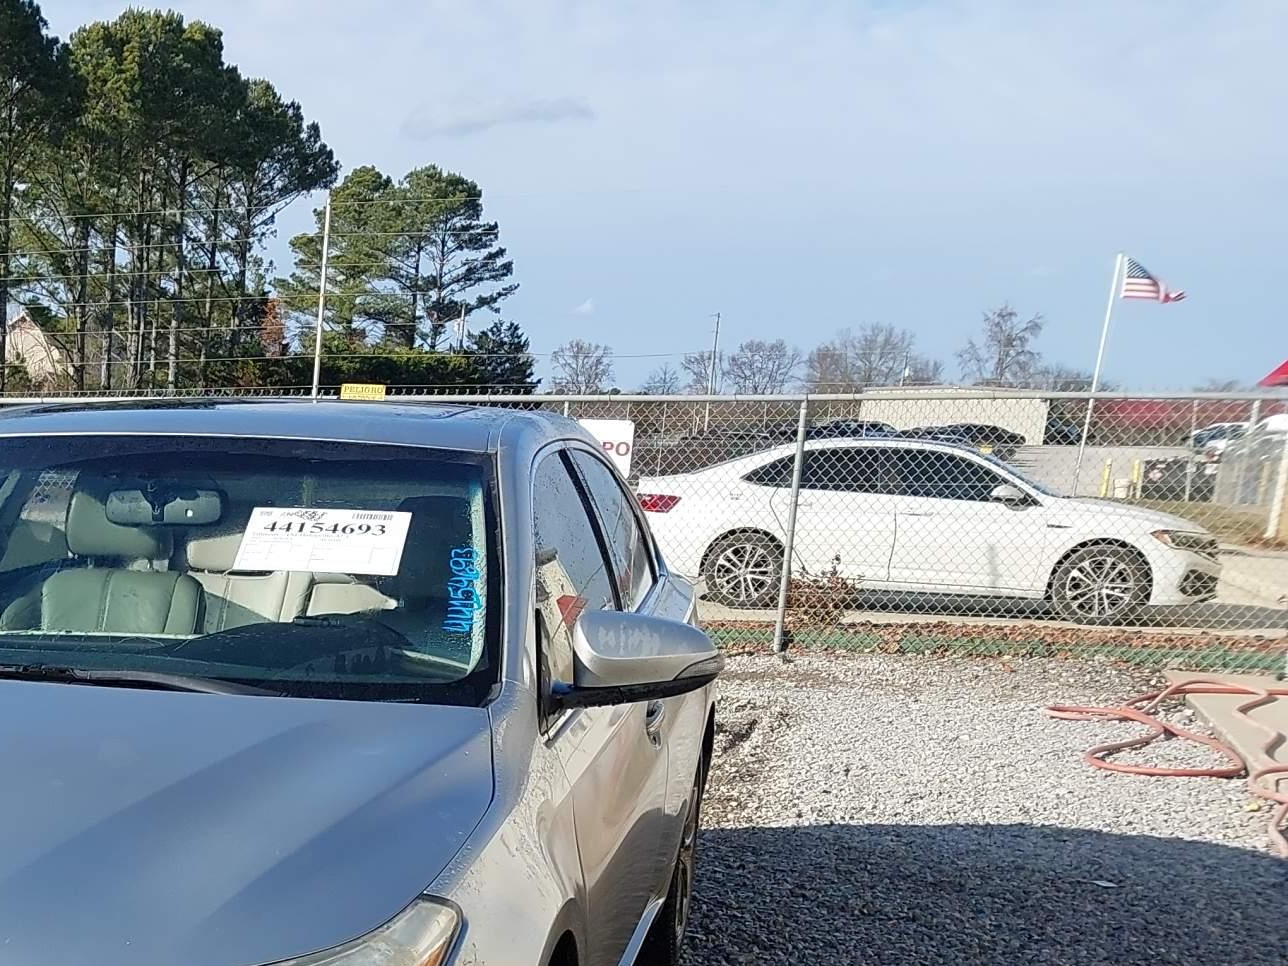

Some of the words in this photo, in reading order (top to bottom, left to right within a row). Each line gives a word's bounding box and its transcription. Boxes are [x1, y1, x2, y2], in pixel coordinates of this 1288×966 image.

[601, 441, 631, 457] PO
[263, 521, 387, 537] 44154693
[440, 547, 481, 633] 44154693
